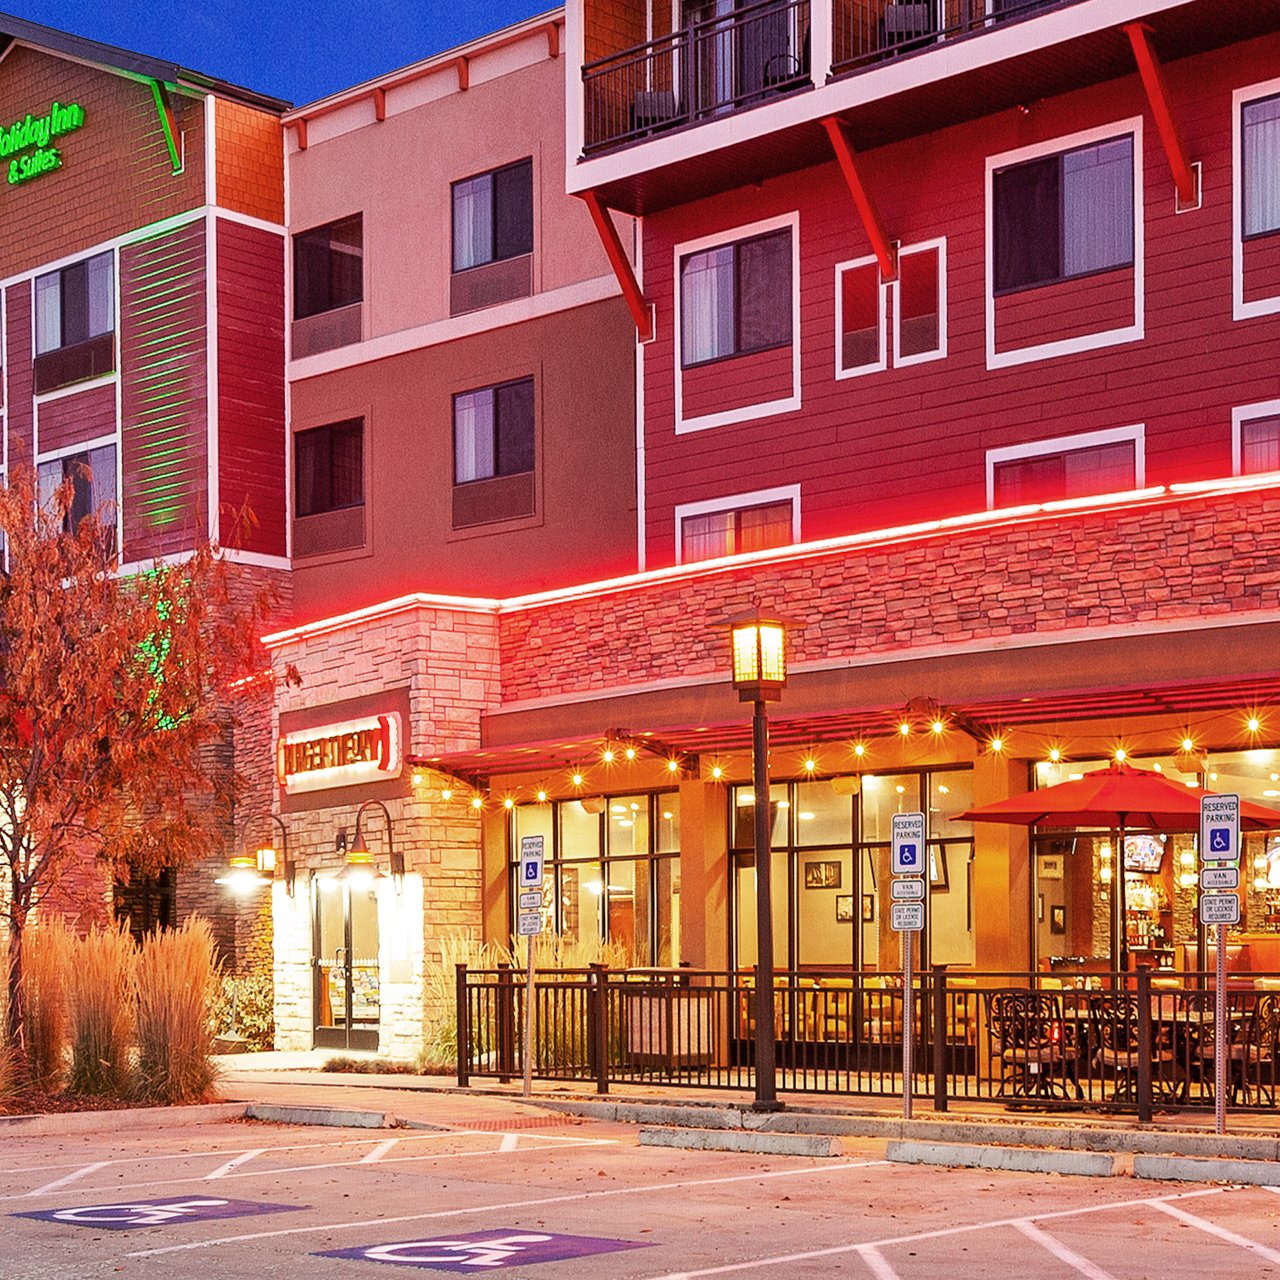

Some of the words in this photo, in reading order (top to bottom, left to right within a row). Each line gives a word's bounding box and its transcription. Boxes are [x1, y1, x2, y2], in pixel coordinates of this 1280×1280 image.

[51, 101, 85, 137] Inn
[19, 148, 62, 179] Suites
[1204, 802, 1237, 812] RESERVED
[1206, 814, 1236, 823] PARKING
[894, 820, 923, 829] RESERVED
[896, 831, 921, 839] PARKING
[524, 850, 542, 858] PARKING
